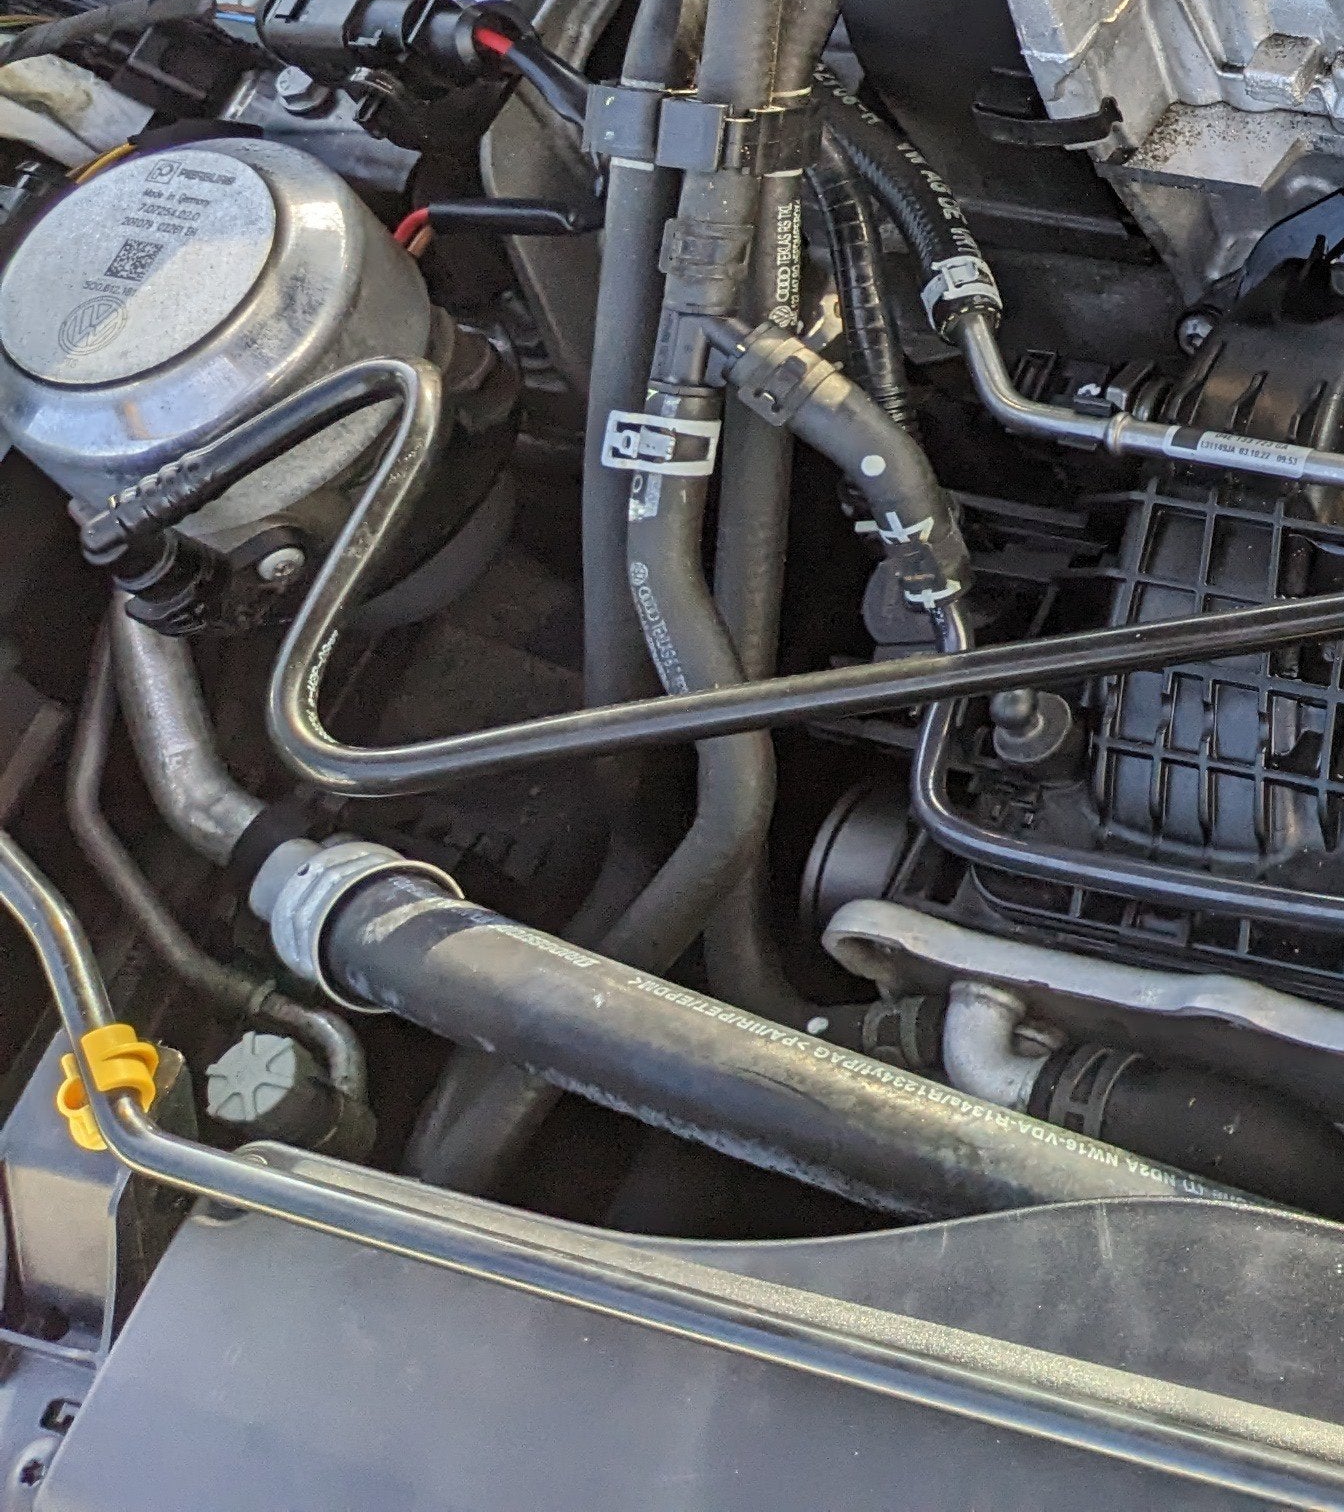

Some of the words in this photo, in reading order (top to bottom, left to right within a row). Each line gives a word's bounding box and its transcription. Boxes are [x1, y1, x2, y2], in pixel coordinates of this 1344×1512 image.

[142, 186, 164, 199] Made
[165, 190, 176, 201] in
[177, 192, 210, 208] Germany
